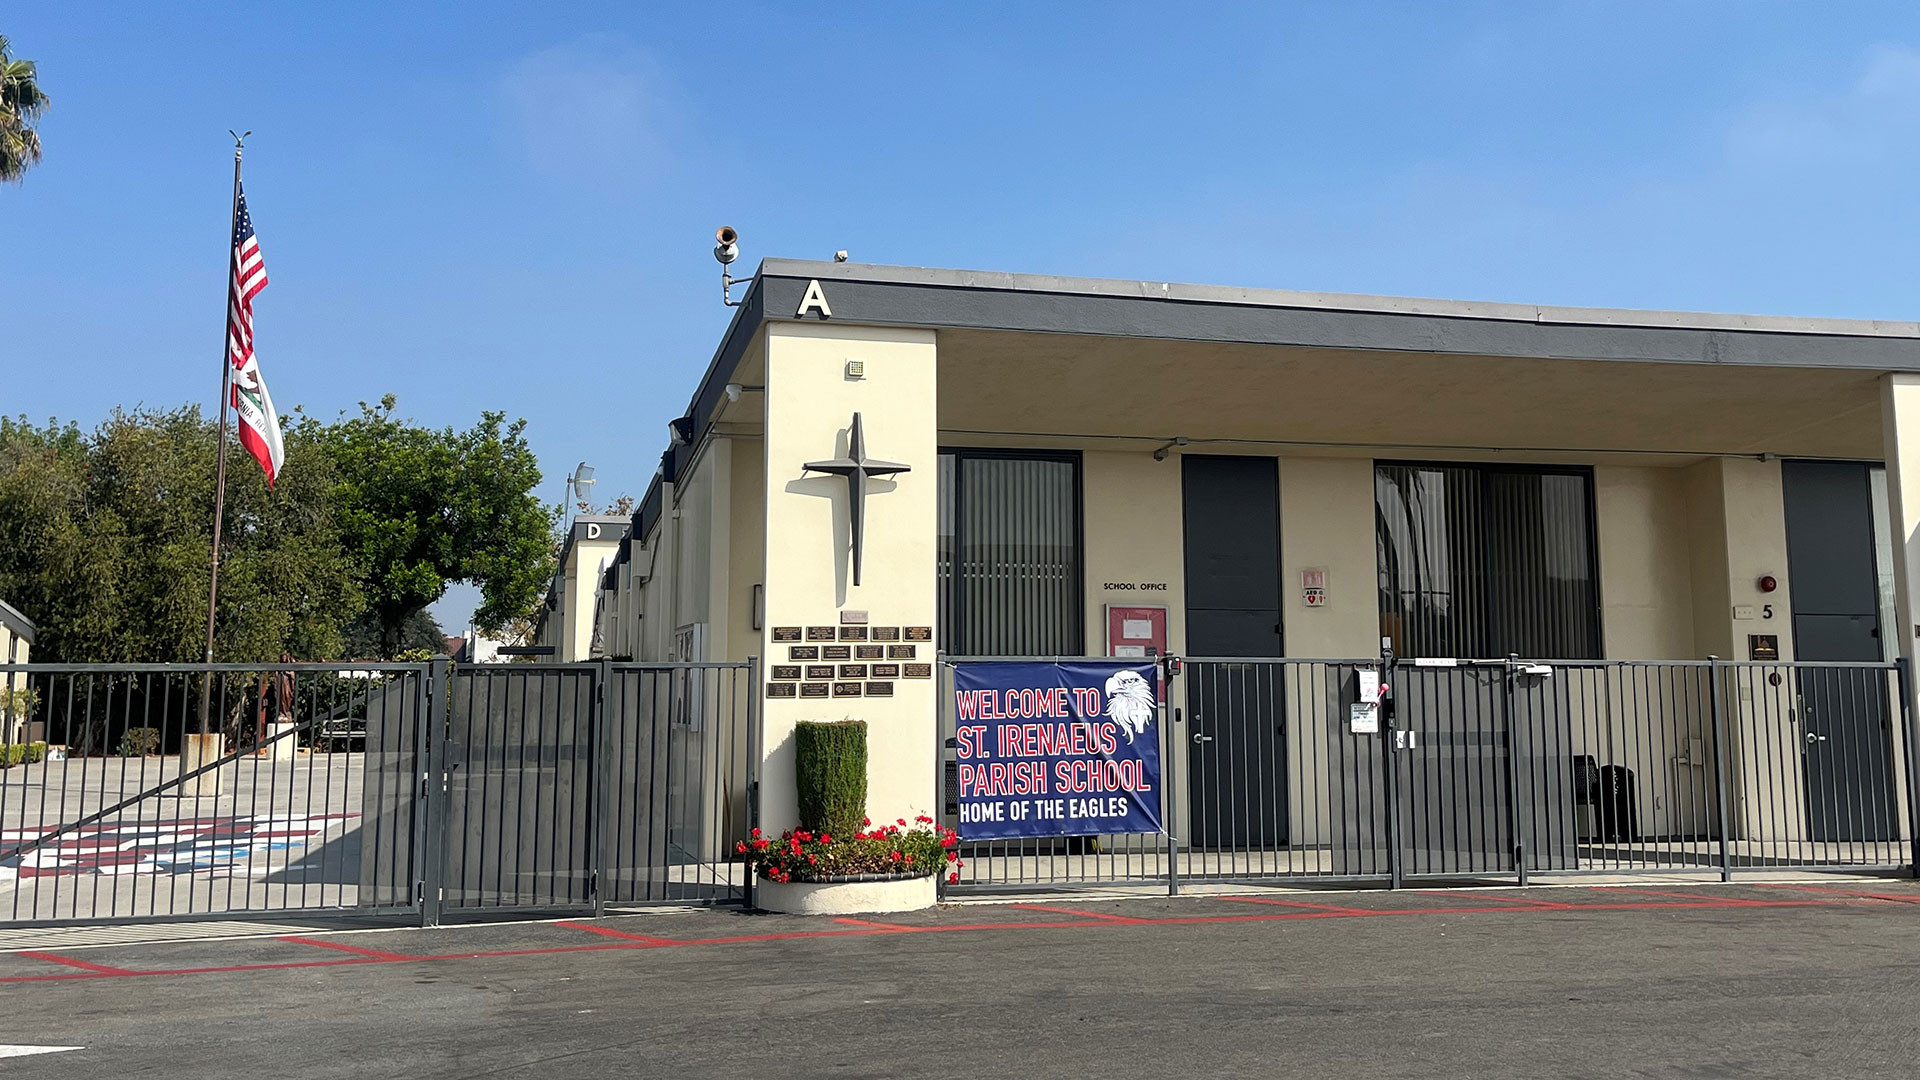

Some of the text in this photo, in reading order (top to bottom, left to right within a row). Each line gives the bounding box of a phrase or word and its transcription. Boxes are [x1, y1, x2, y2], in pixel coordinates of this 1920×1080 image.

[797, 279, 833, 316] A
[587, 523, 601, 539] D
[1103, 582, 1168, 591] SCHOOL OFFICE
[1763, 604, 1773, 620] 5
[956, 687, 1101, 720] WELCOME TO
[957, 722, 1117, 759] ST. IRENAEUS
[960, 759, 1151, 797] PARISH SCHOOL
[959, 797, 1128, 823] HOME OF THE EAGLES
